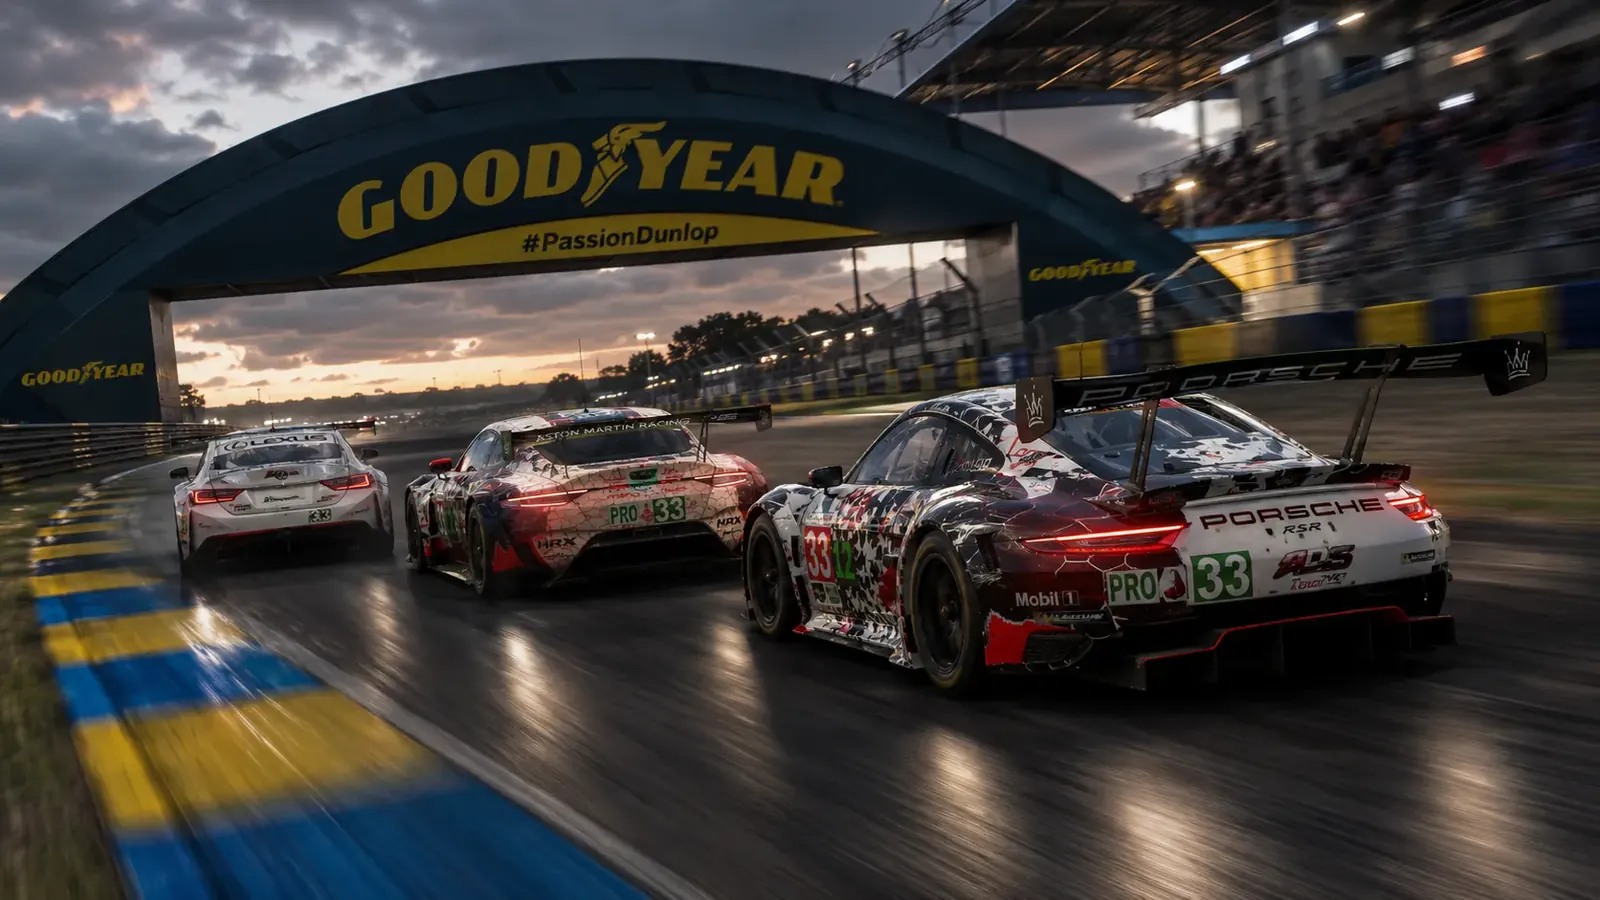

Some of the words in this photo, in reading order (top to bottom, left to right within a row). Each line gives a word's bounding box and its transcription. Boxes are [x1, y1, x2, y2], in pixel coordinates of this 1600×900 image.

[337, 134, 845, 240] GOODYEAR
[522, 223, 719, 253] #PassionDunlop
[1028, 259, 1137, 281] GOODYEAR
[21, 361, 145, 387] GOODYEAR
[1080, 353, 1463, 406] PORSCHE
[536, 428, 580, 443] ASTON
[584, 422, 635, 435] MARTIN
[639, 417, 692, 429] RACING
[610, 504, 638, 525] PRO
[654, 496, 684, 522] 33
[1200, 497, 1385, 530] PORSCHE
[1283, 521, 1322, 535] RSR
[804, 530, 832, 579] 33
[1108, 571, 1157, 602] PRO
[1197, 553, 1250, 600] 33
[1015, 591, 1060, 607] Mobil
